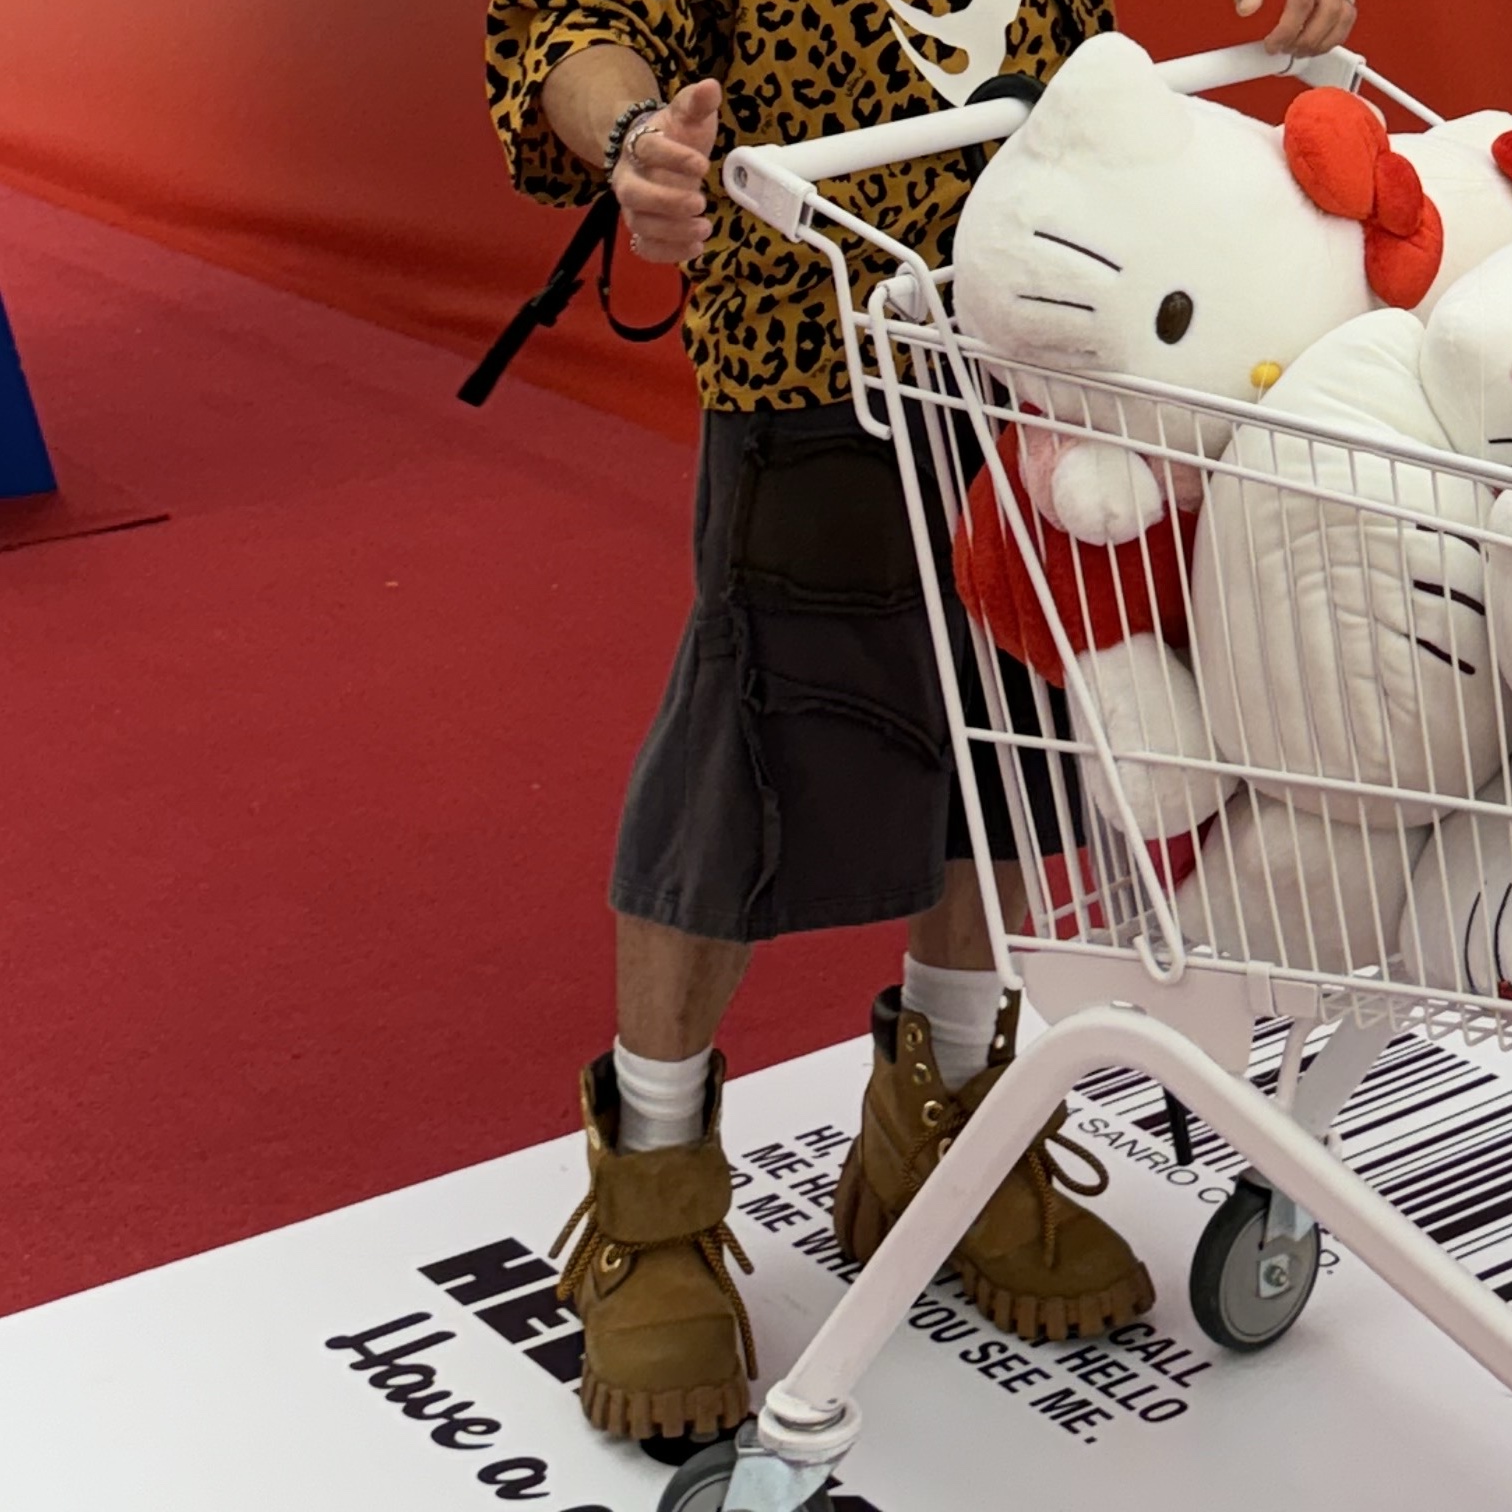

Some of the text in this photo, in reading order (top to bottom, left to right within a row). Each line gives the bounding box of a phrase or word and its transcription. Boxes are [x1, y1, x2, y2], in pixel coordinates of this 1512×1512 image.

[794, 1124, 1213, 1388] HI, CALL
[1077, 1118, 1200, 1186] SANRIO
[324, 1311, 503, 1450] Have
[476, 1456, 551, 1501] a
[737, 1193, 813, 1233] ME
[958, 1340, 1052, 1393] SEE
[1029, 1387, 1114, 1445] ME.
[741, 1142, 1189, 1423] ME HELLO
